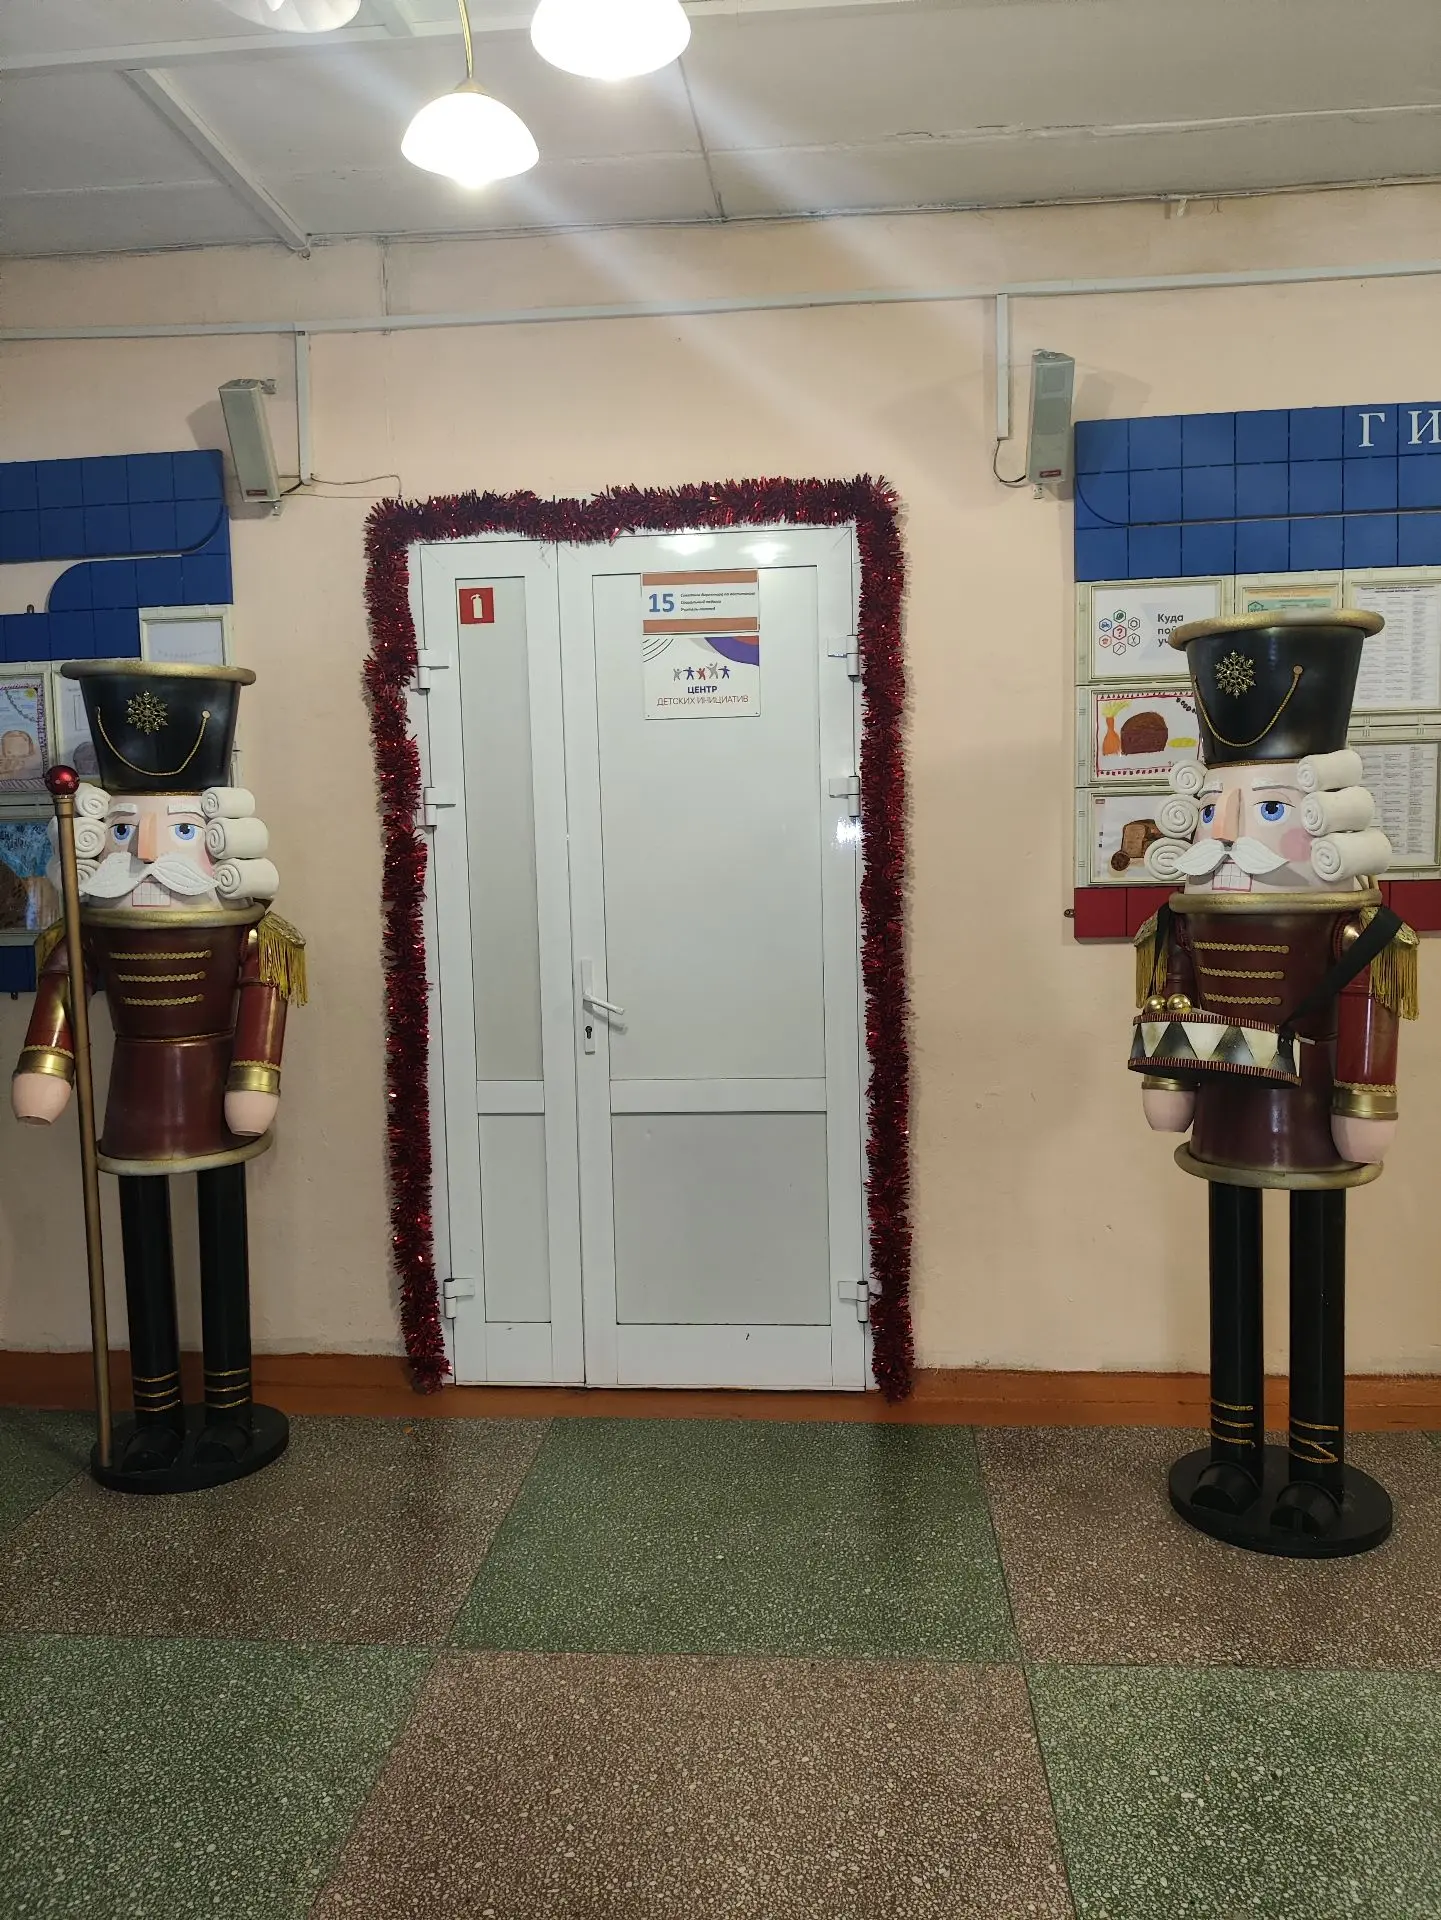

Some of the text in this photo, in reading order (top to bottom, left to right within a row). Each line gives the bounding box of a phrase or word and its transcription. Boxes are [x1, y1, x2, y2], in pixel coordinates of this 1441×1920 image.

[648, 593, 675, 612] 15
[1157, 613, 1184, 624] Куда
[687, 685, 718, 694] ЦЕНТР
[656, 694, 749, 706] ДЕТСКИХ ИНИЦИАТИВ
